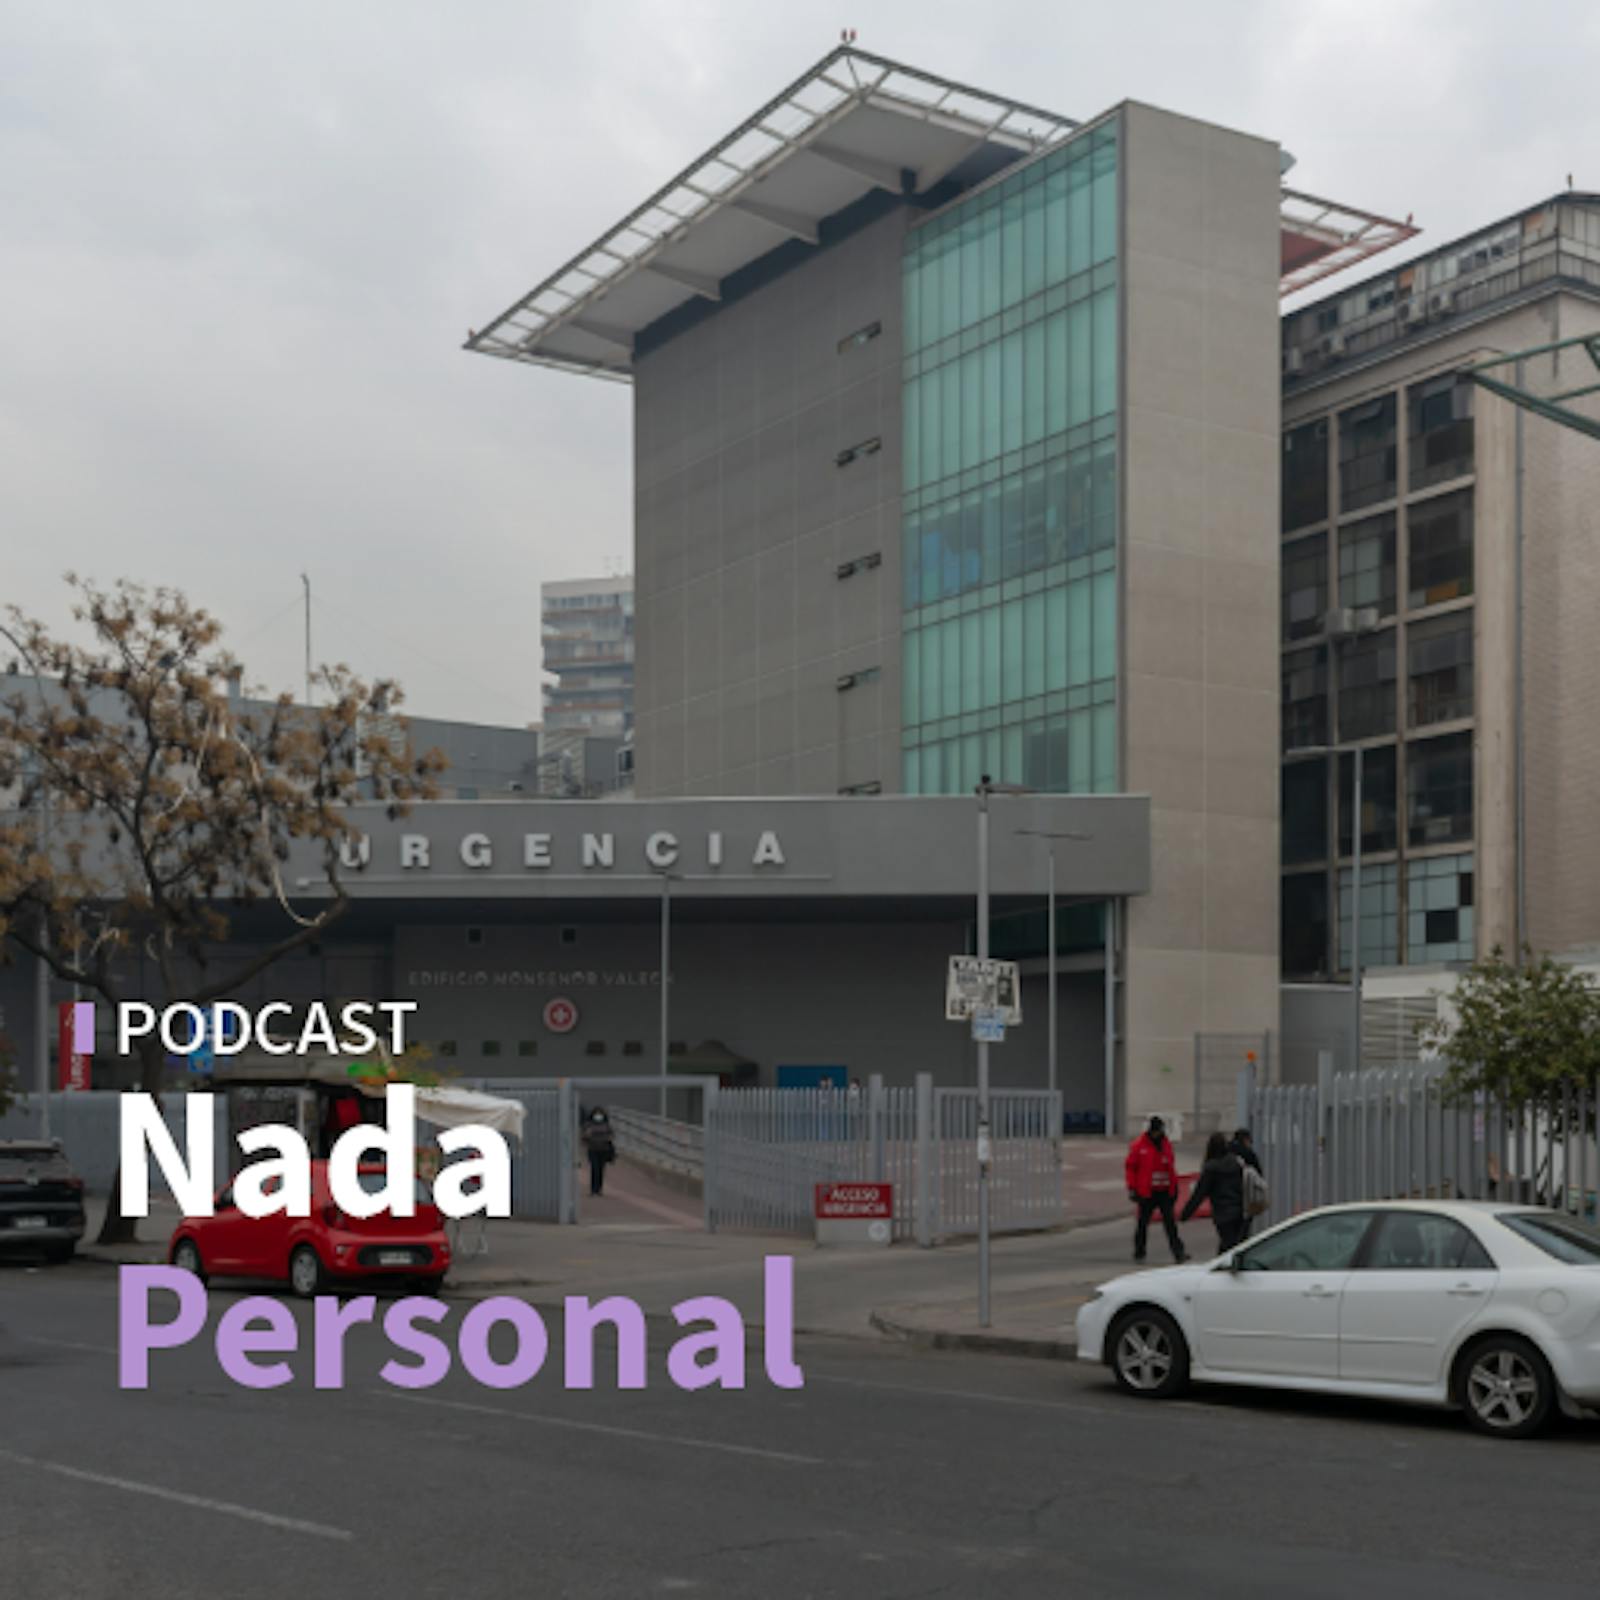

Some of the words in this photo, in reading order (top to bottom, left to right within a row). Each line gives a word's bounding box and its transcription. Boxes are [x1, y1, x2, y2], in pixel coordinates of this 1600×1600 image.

[339, 830, 787, 869] URGENCIA
[408, 971, 489, 986] EDIFICIO
[832, 1186, 881, 1201] ACCESO
